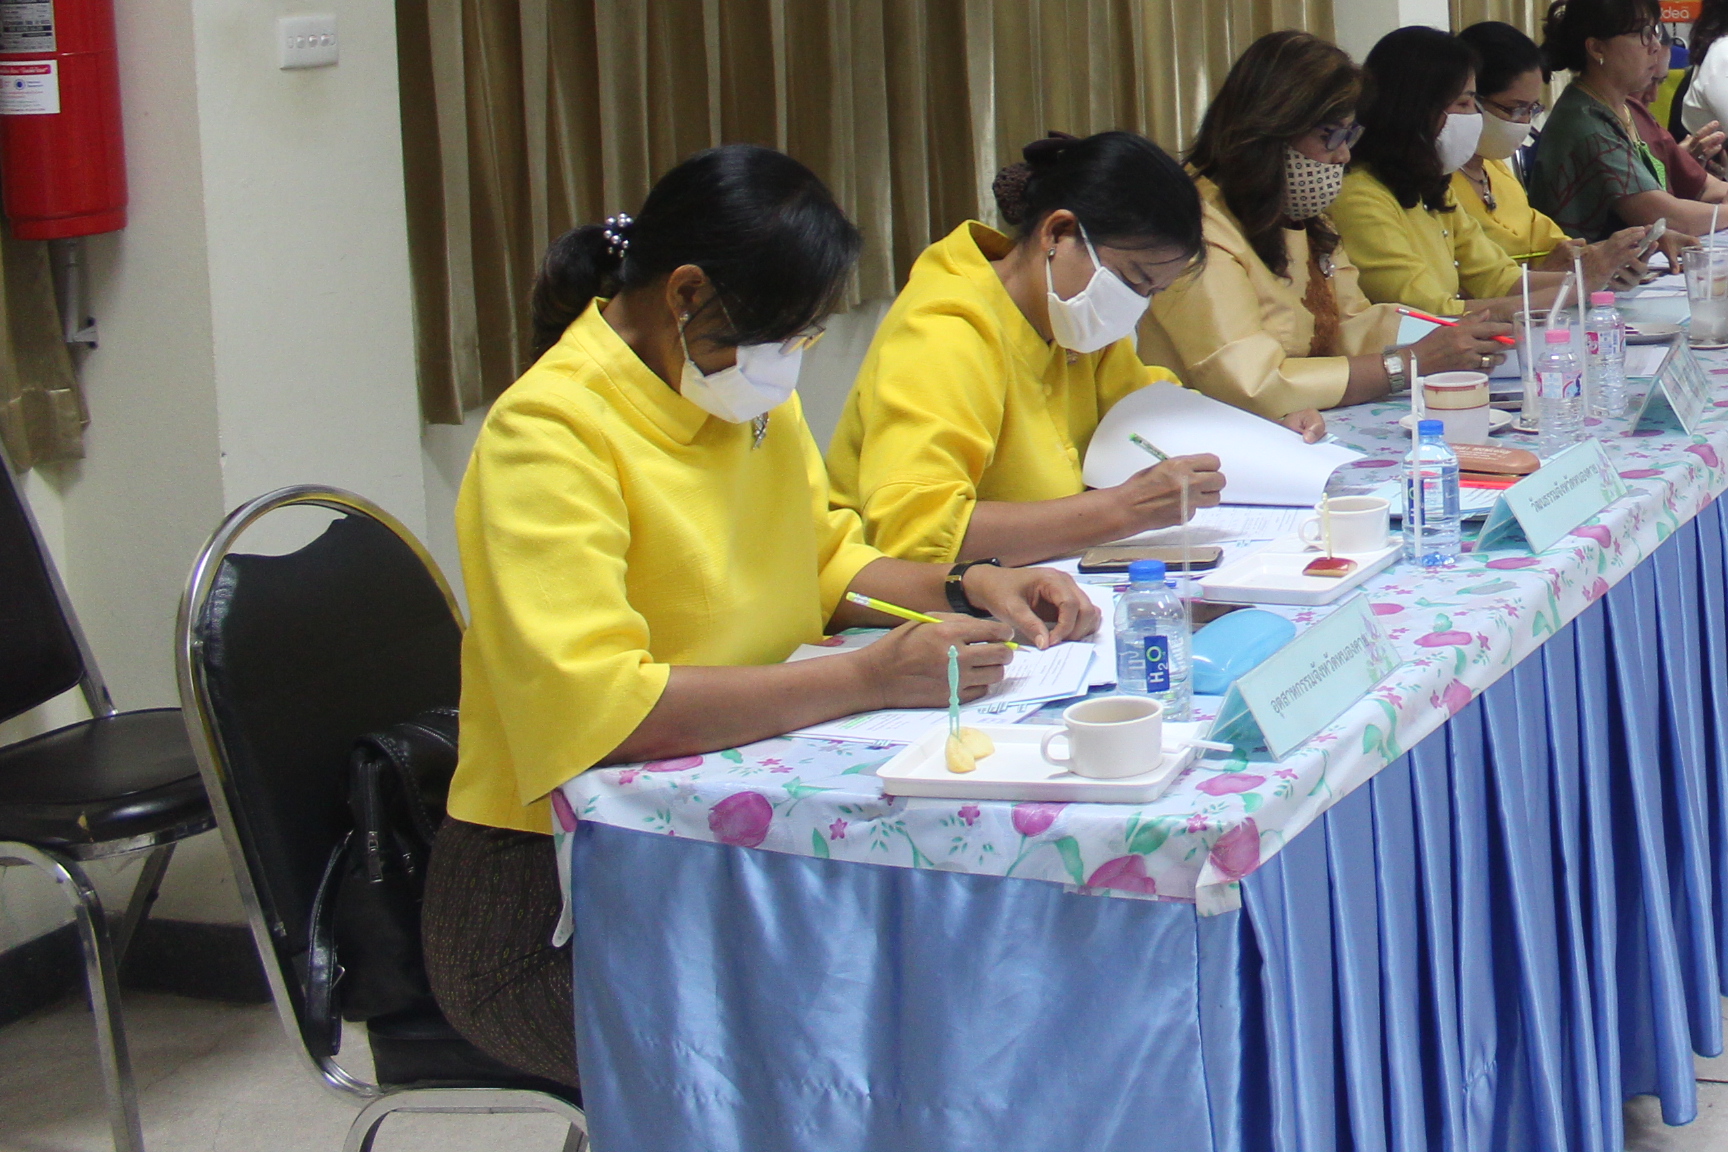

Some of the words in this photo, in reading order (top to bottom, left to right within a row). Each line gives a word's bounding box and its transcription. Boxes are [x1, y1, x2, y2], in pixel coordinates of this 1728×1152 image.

[1270, 634, 1370, 718] อุตสาหกรรมจังหวัดหนองคาย
